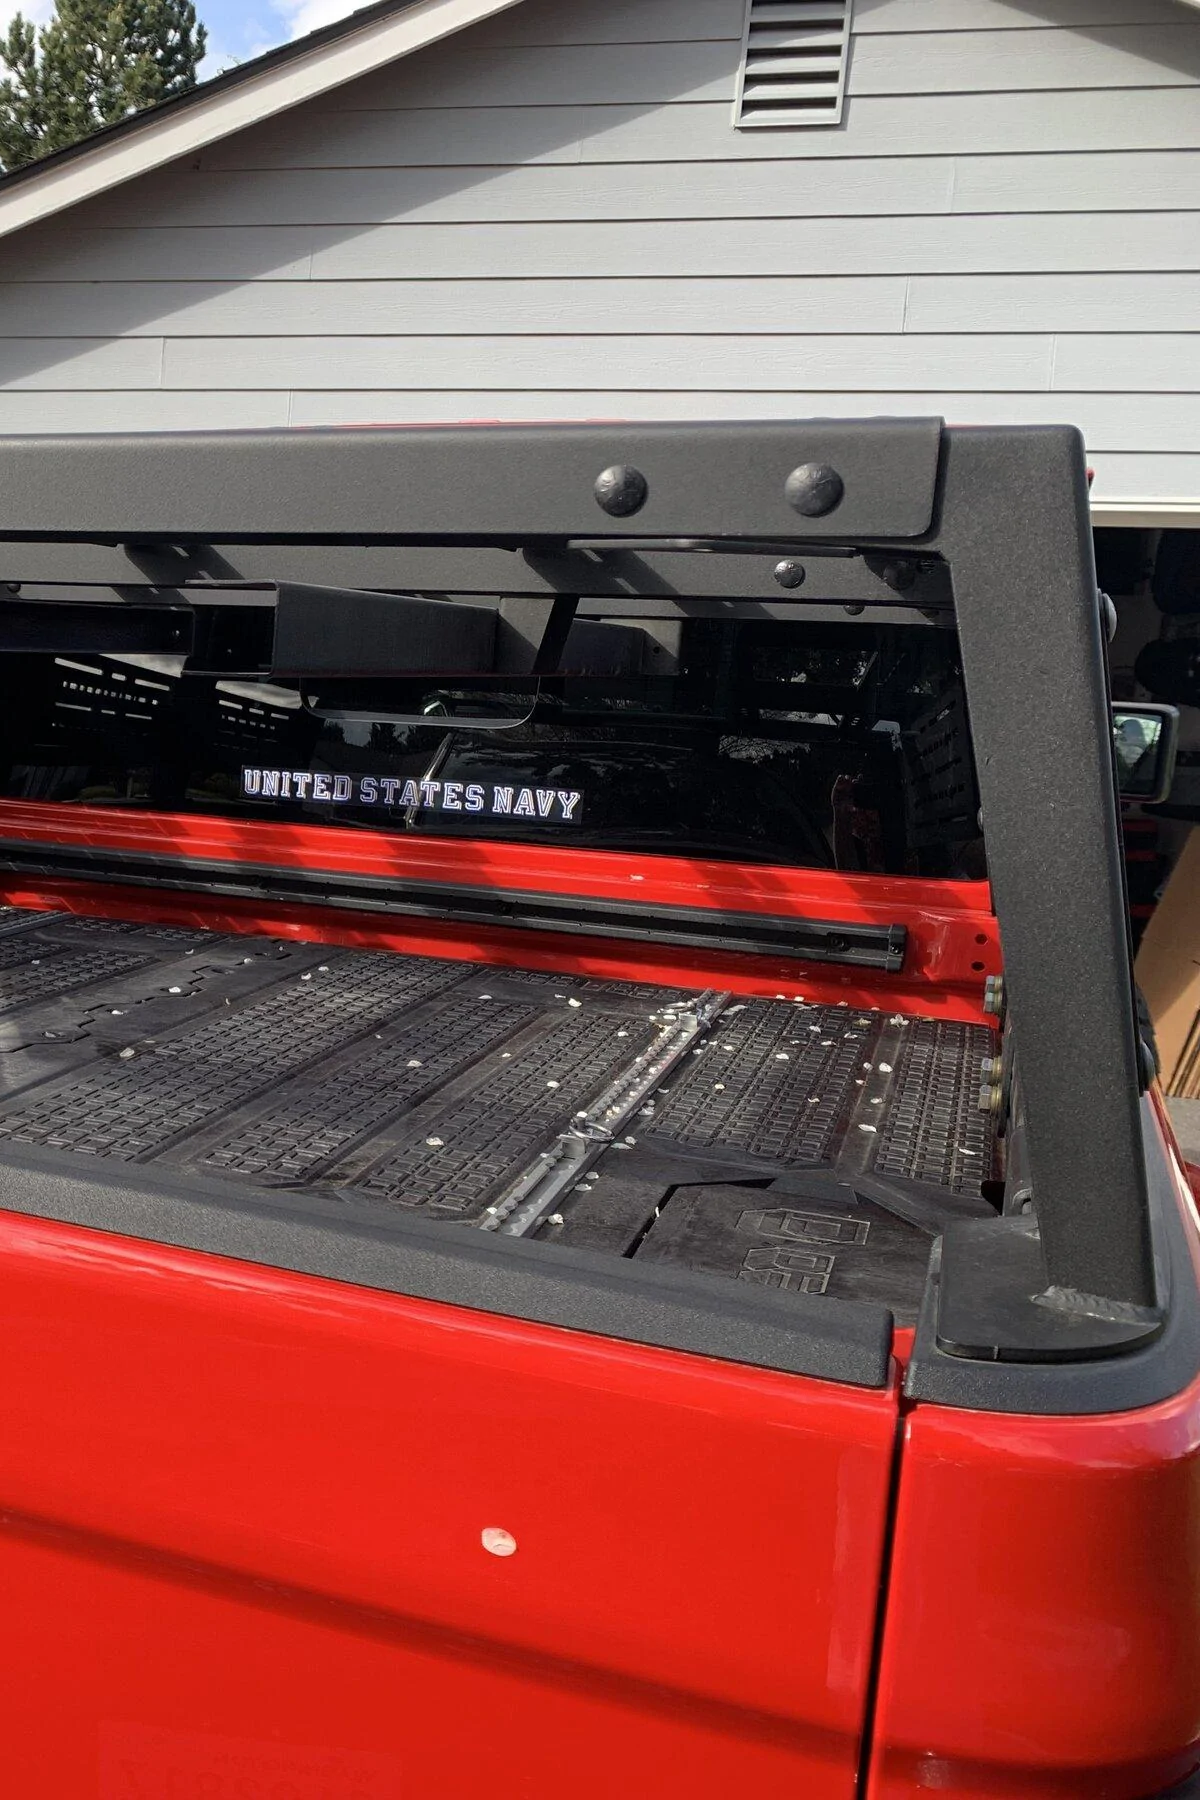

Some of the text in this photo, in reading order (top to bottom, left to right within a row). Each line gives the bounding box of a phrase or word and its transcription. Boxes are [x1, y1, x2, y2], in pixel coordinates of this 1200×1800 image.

[243, 769, 582, 819] UNITED STATES NAVY
